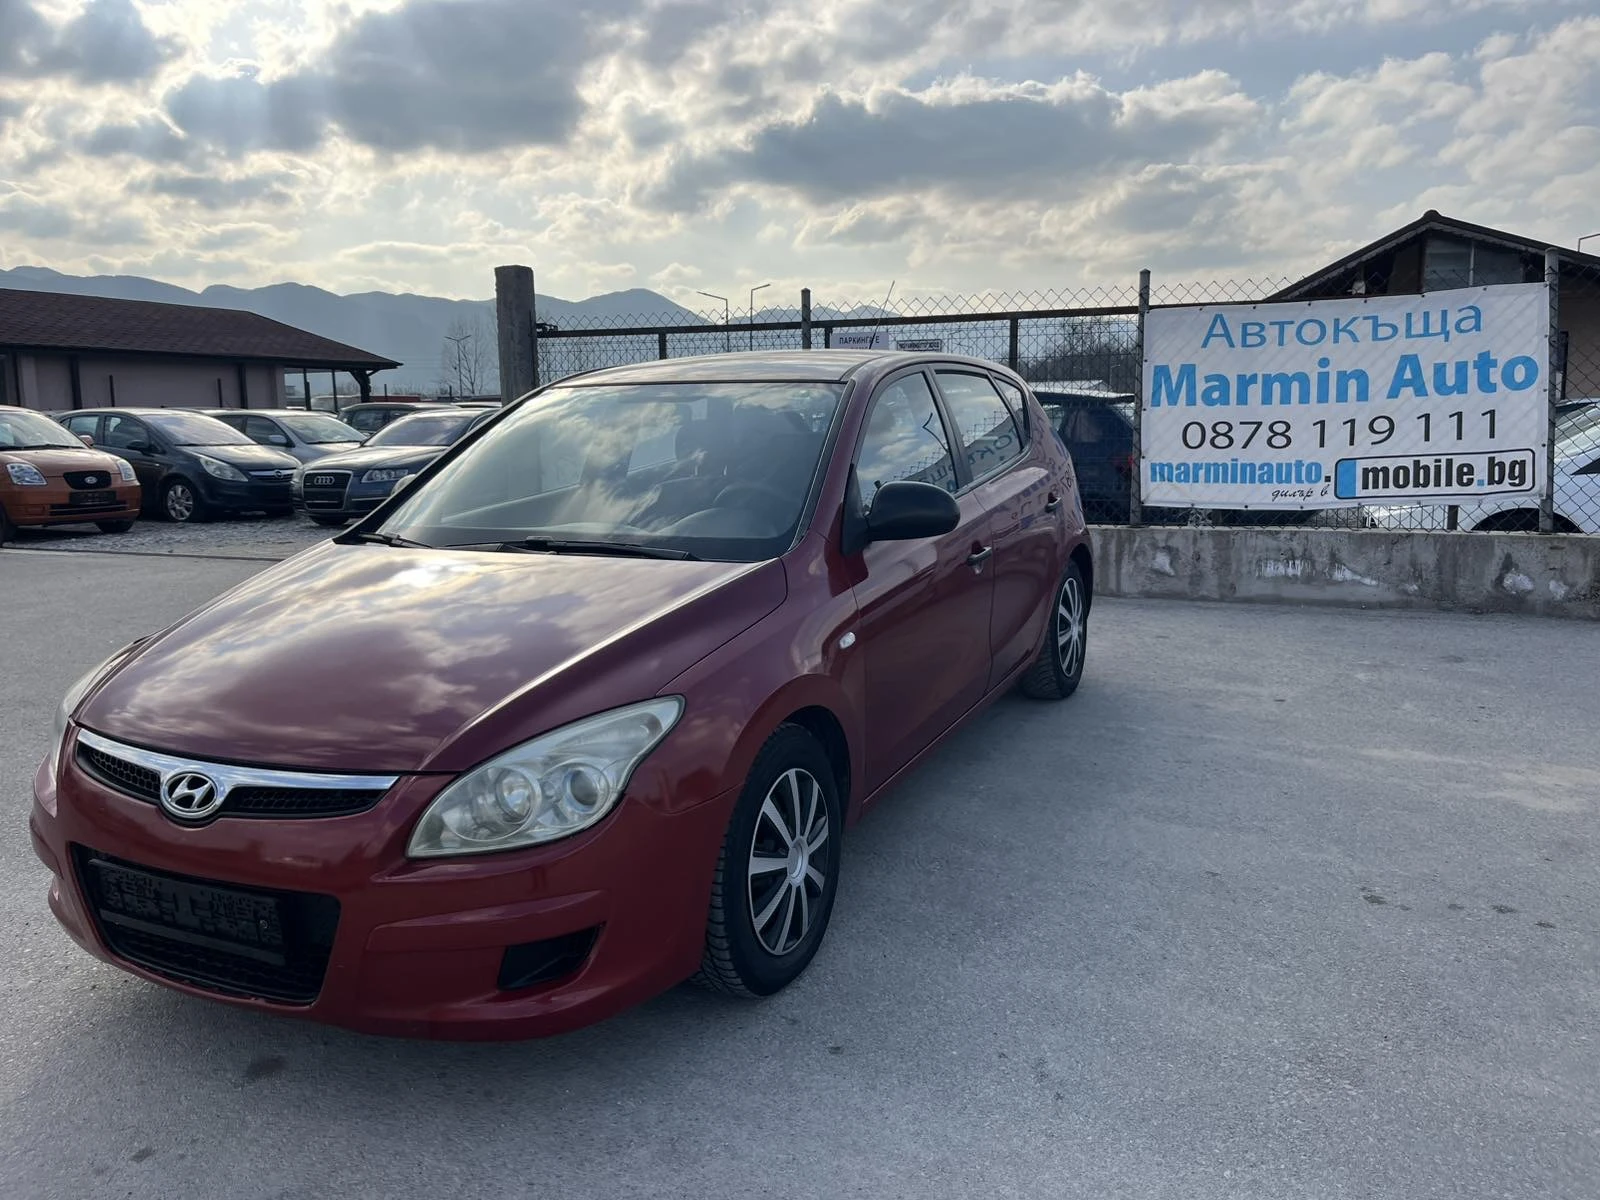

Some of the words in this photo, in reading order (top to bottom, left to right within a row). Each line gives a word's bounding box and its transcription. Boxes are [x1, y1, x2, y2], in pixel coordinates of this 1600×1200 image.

[1201, 305, 1482, 348] Автокъща
[1150, 357, 1369, 407] Marmin
[1386, 349, 1540, 399] Auto
[1181, 420, 1292, 449] 0878
[1312, 415, 1396, 449] 119
[1416, 408, 1497, 442] 111
[1361, 456, 1527, 490] mobile.bg
